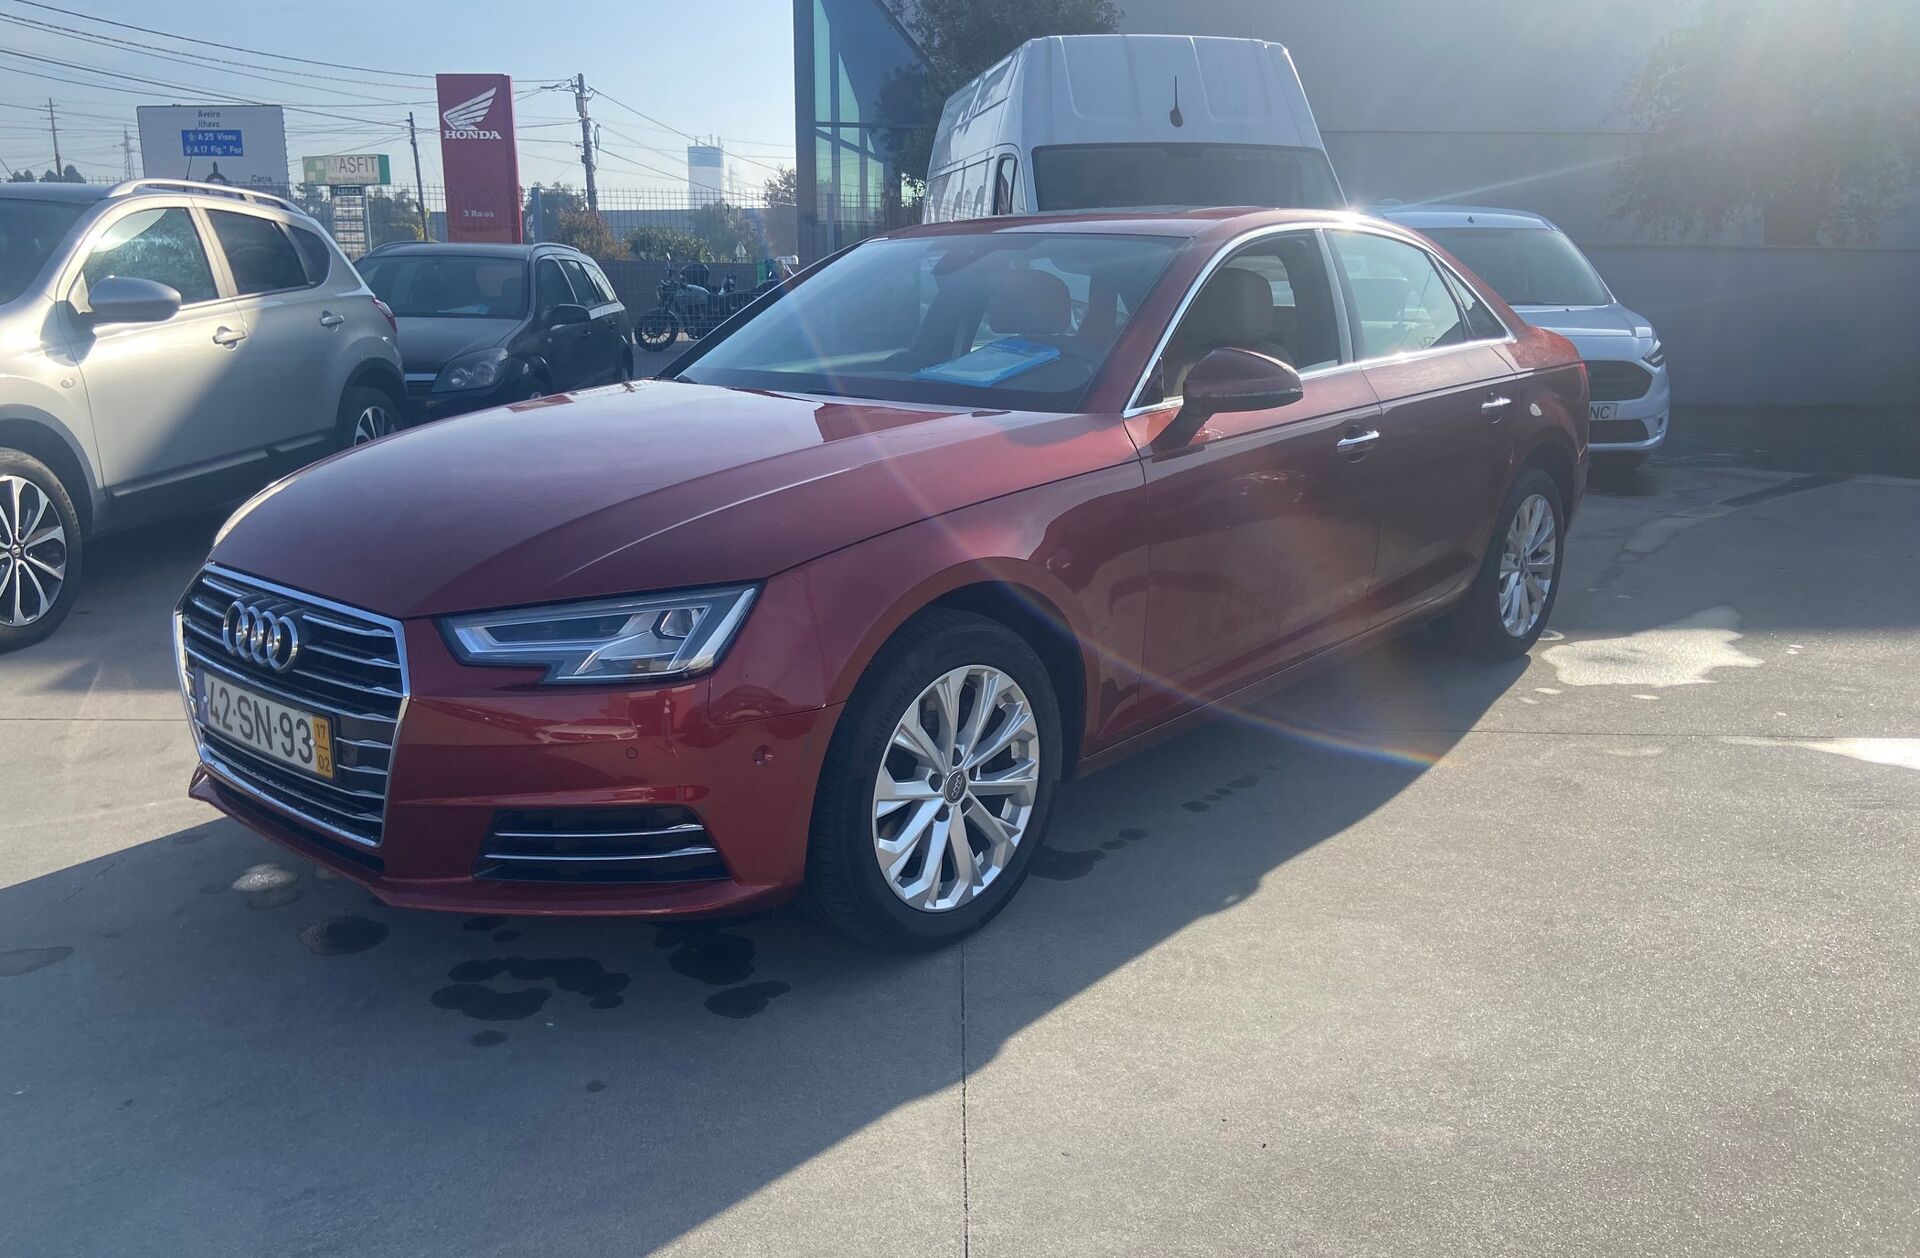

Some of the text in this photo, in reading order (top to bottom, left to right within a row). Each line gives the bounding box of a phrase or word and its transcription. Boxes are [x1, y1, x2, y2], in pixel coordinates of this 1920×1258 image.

[198, 110, 220, 118] Aveiro
[217, 133, 237, 141] Viseu
[444, 130, 502, 139] HONDA
[327, 156, 376, 174] MASFIT
[251, 175, 272, 183] Cacia
[471, 209, 495, 218] Raios
[316, 722, 326, 743] 17
[318, 755, 331, 773] 02
